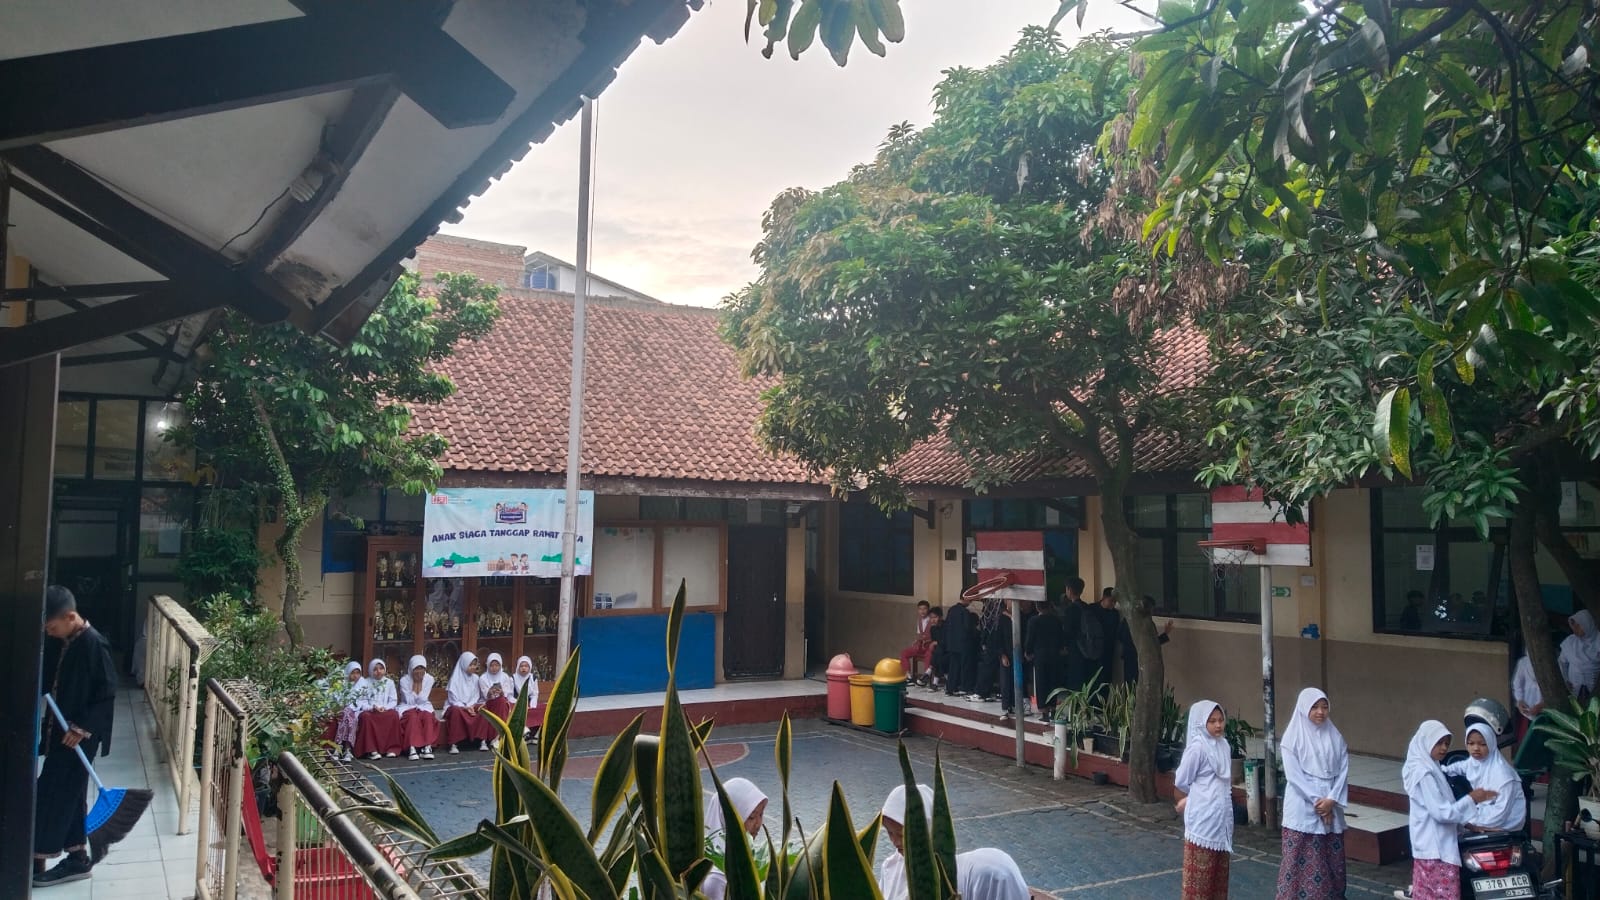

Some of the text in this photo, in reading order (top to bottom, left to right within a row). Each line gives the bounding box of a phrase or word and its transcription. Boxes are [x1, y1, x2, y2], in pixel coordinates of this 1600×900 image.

[432, 532, 456, 543] ANAK
[458, 530, 487, 540] SIAGA
[489, 529, 530, 537] TANGGAP
[1486, 879, 1507, 889] 3781
[1511, 875, 1528, 886] ACR
